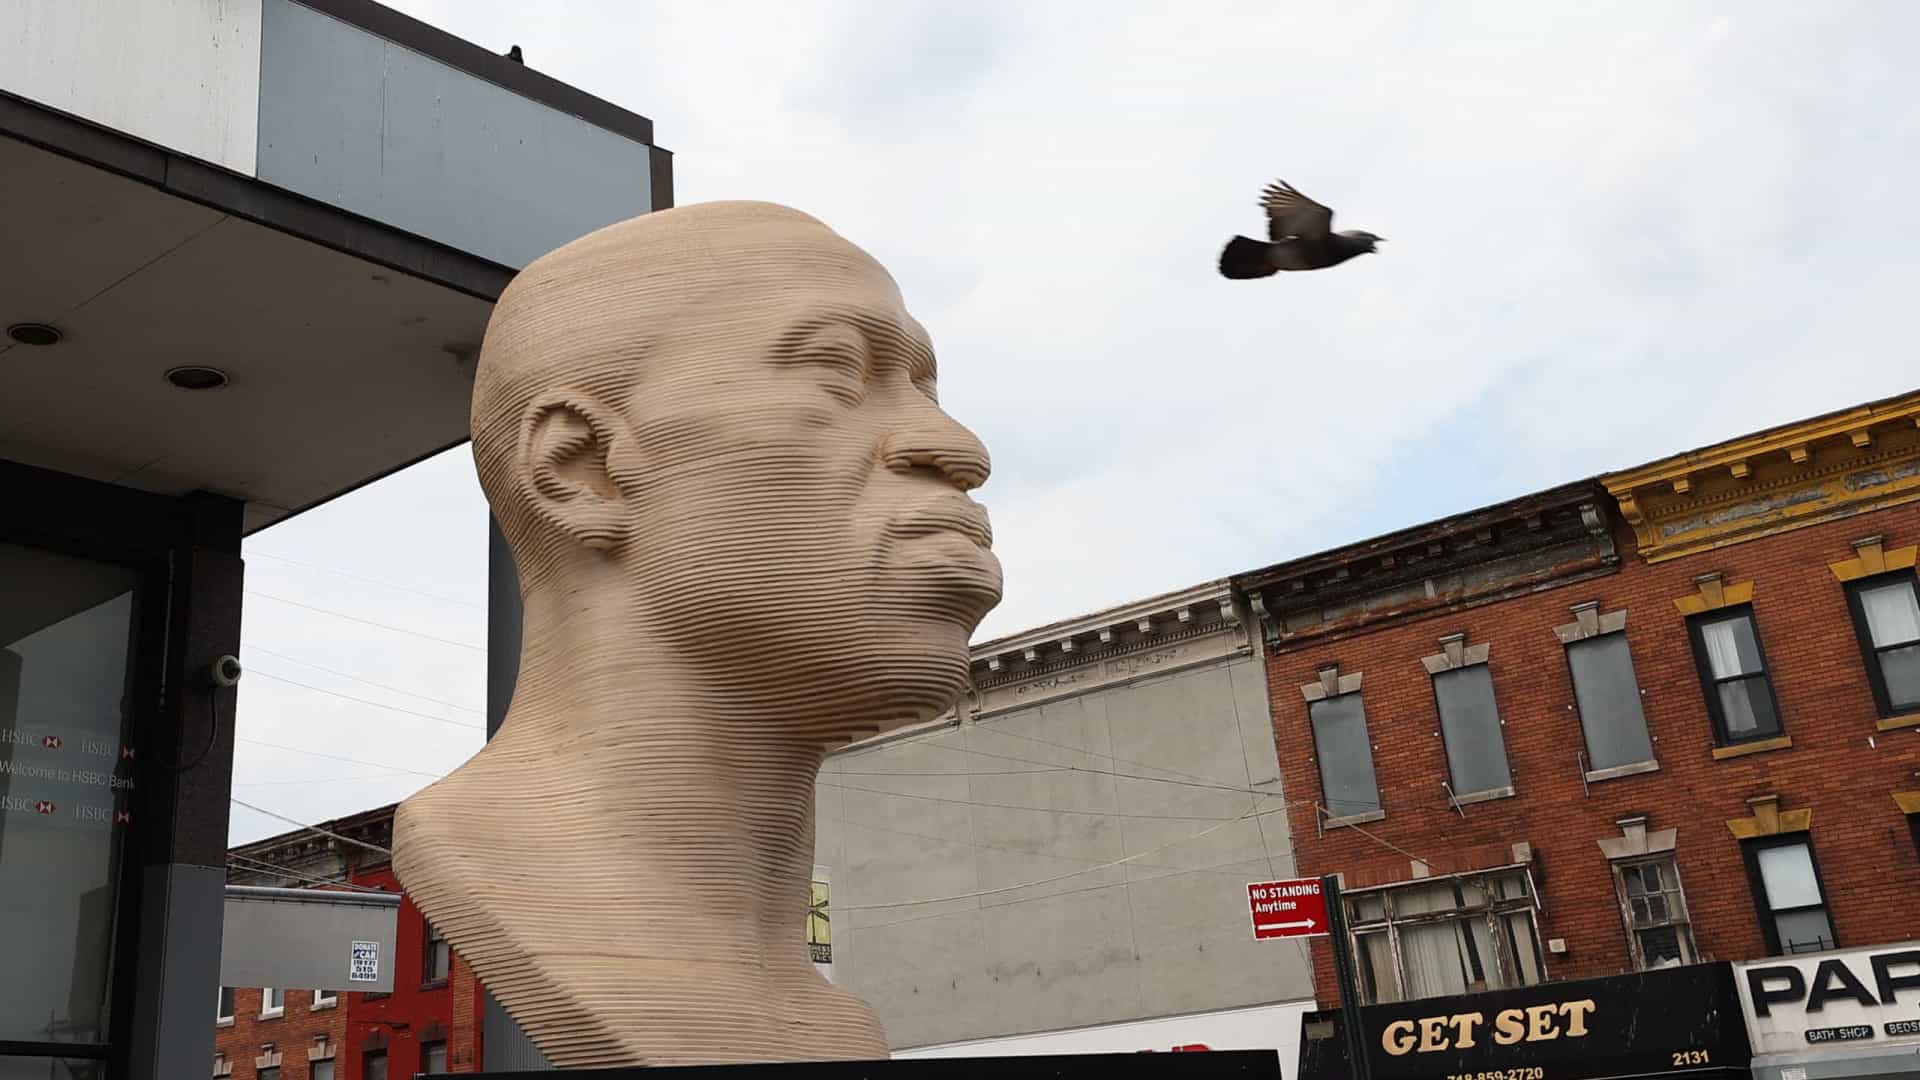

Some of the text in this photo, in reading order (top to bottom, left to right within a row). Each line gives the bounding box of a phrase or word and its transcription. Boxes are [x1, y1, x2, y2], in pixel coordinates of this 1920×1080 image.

[0, 759, 135, 790] Welcome to HSBC Bank
[1252, 884, 1320, 900] NO STANDING
[1255, 900, 1297, 914] Anytime
[1382, 999, 1596, 1055] GET SET
[1808, 1027, 1868, 1041] BATH SHOP
[1888, 1021, 1920, 1034] BEDS
[1672, 1049, 1709, 1066] 2131
